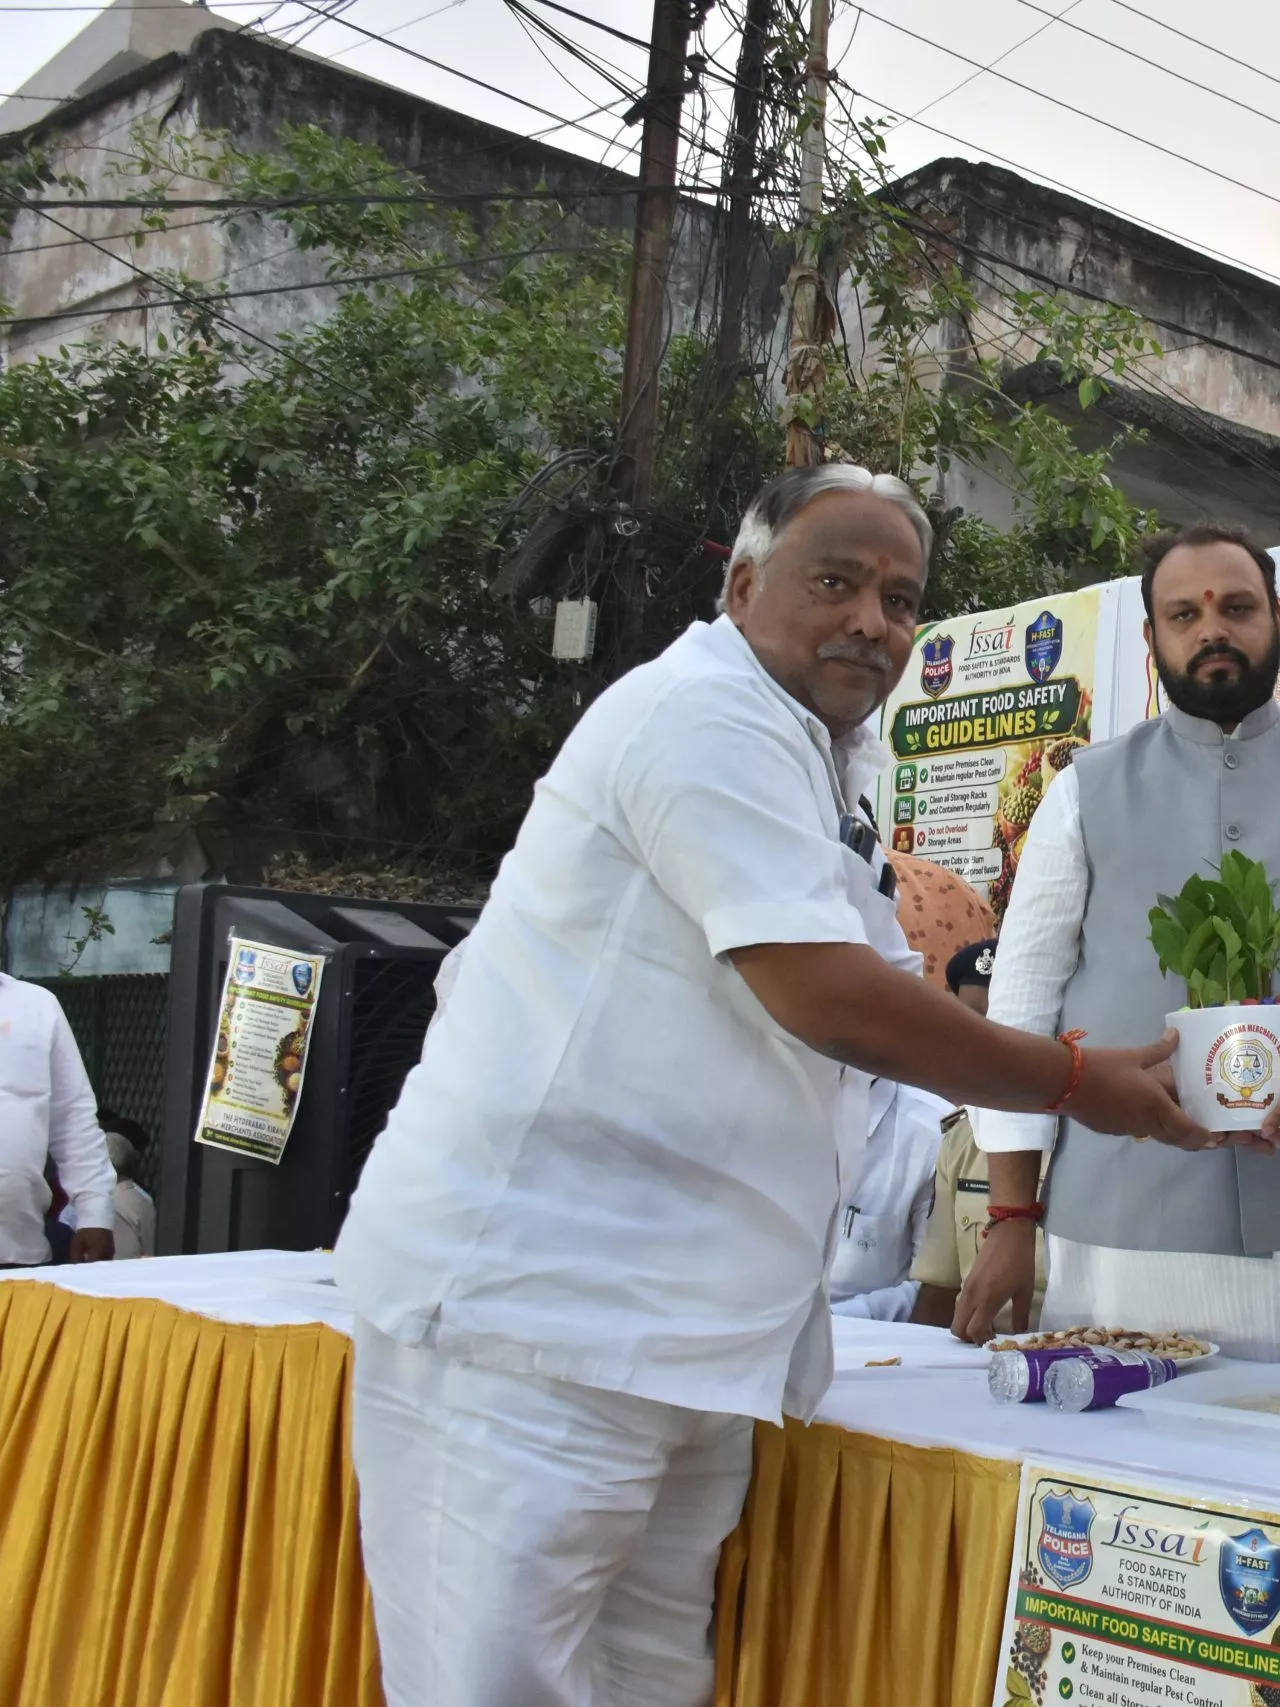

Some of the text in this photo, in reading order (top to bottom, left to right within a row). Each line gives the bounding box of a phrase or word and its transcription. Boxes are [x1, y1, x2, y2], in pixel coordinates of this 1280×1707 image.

[964, 614, 1016, 661] fssai
[1031, 627, 1056, 641] H-FAST
[924, 664, 951, 677] POLICE
[905, 683, 1067, 727] IMPORTANT FOOD SAFETY
[926, 709, 1037, 749] GUIDELINES
[931, 764, 943, 772] Keep
[944, 763, 954, 772] your
[955, 759, 979, 769] Premises
[975, 769, 987, 779] Pest
[950, 792, 970, 803] Storage
[970, 790, 987, 800] Racks
[938, 804, 964, 815] Containers
[965, 801, 991, 812] Regularly
[928, 823, 968, 836] Do not Overload
[928, 836, 962, 848] Storage Areas
[951, 856, 963, 866] Cuts
[1046, 1524, 1087, 1540] TELANGANA
[1100, 1505, 1209, 1567] fssai
[1043, 1533, 1089, 1555] POLICE
[1119, 1558, 1187, 1584] FOOD SAFETY
[1235, 1555, 1270, 1570] H-FAST
[1117, 1573, 1187, 1600] & STANDARDS
[1101, 1585, 1202, 1620] AUTHORITY OF INDIA
[1025, 1596, 1099, 1629] IMPORTANT
[1101, 1615, 1139, 1640] FOOD
[1142, 1626, 1195, 1655] SAFETY
[1081, 1643, 1196, 1687] Keep your Premises Clean
[1080, 1661, 1089, 1674] &
[1091, 1663, 1130, 1686] Maintain
[1131, 1679, 1163, 1695] regular
[1165, 1685, 1184, 1701] Pest
[1079, 1683, 1104, 1701] Clean
[1106, 1692, 1118, 1705] all
